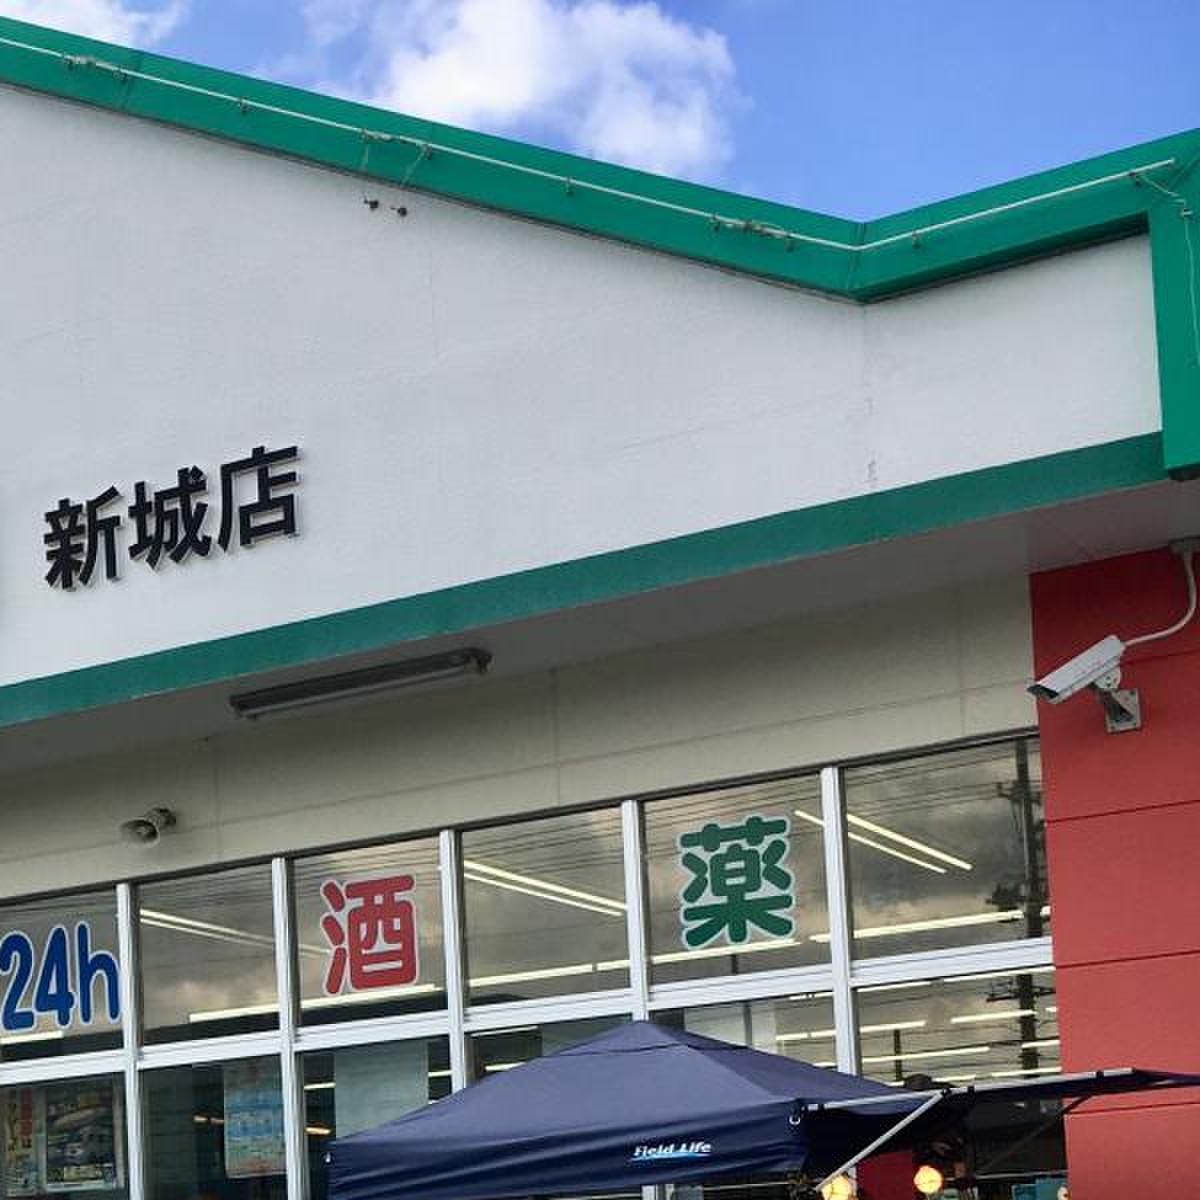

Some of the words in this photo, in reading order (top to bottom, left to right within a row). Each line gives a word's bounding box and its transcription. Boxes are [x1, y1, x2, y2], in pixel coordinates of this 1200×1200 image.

[43, 445, 302, 590] 新城店
[321, 875, 419, 995] 酒
[680, 816, 794, 948] 薬
[0, 922, 121, 1031] 24h
[633, 1143, 675, 1157] Field
[679, 1141, 711, 1153] Life
